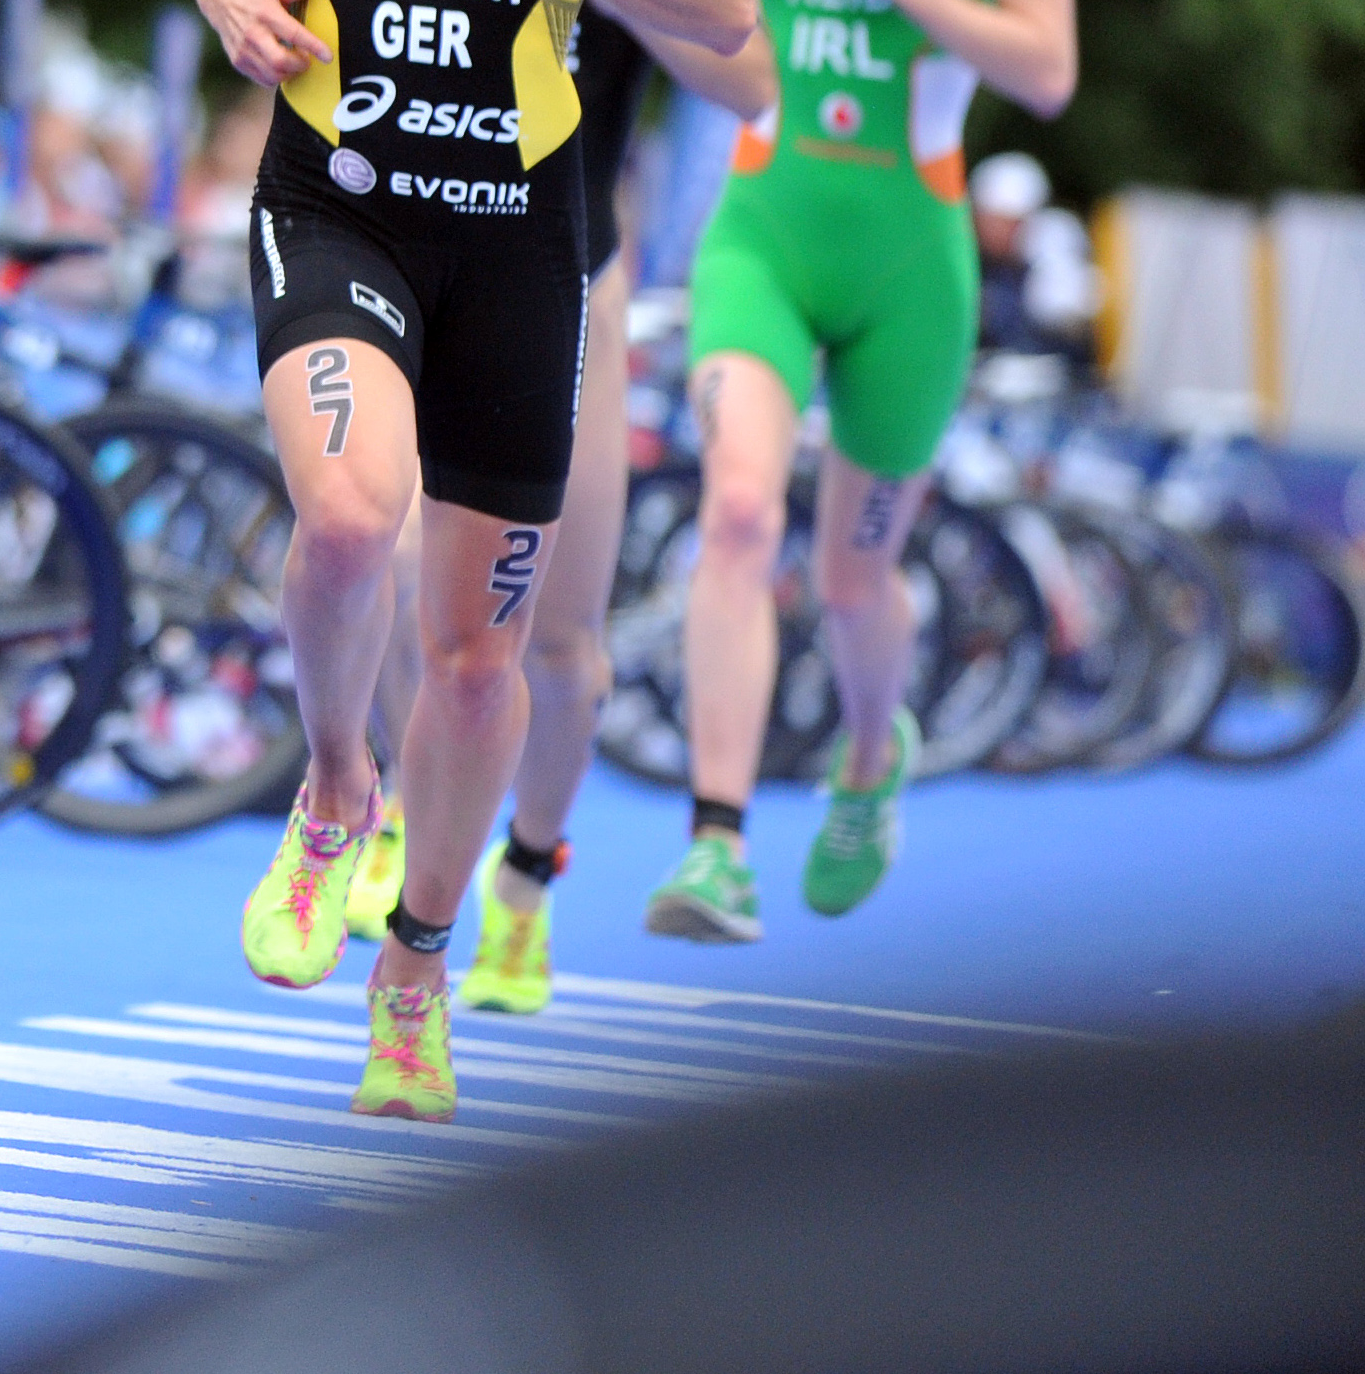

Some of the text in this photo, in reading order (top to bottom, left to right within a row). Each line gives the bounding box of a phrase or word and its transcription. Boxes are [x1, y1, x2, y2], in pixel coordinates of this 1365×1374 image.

[371, 0, 473, 69] GER
[788, 13, 896, 81] IRL
[396, 98, 524, 144] asics
[389, 170, 531, 206] EVONIK
[451, 204, 528, 215] INDUSTRIES
[306, 346, 355, 458] 27
[489, 527, 542, 627] 27
